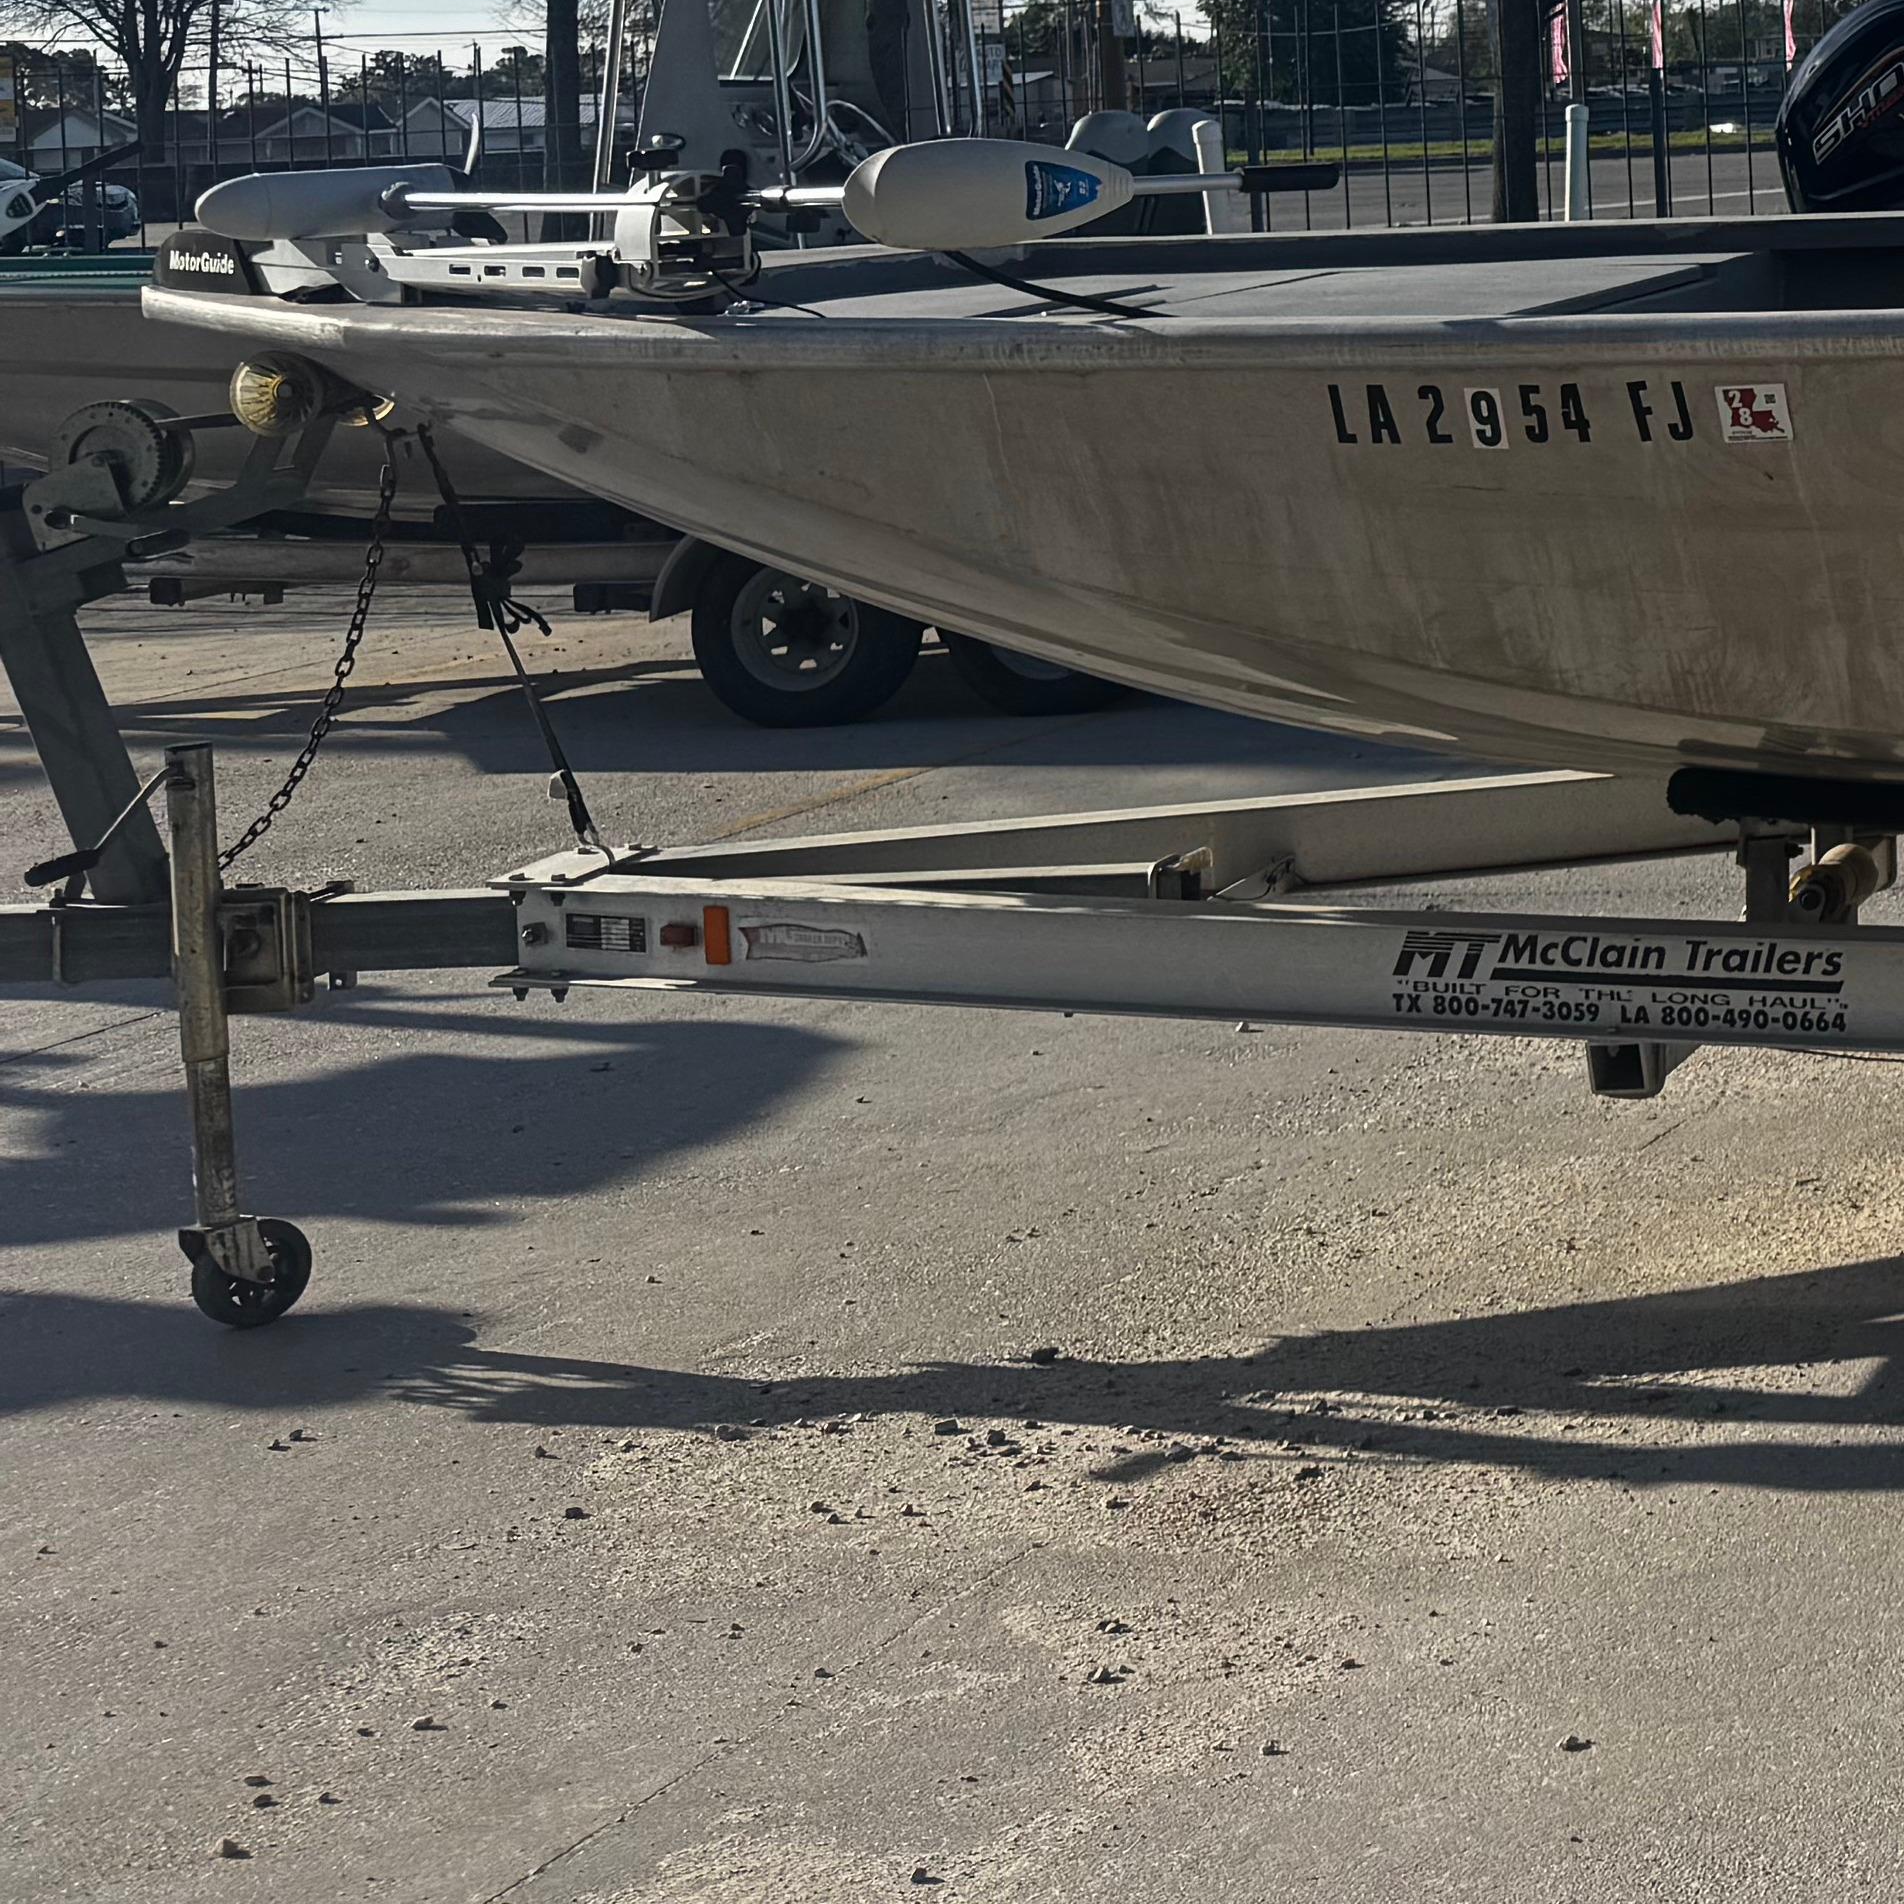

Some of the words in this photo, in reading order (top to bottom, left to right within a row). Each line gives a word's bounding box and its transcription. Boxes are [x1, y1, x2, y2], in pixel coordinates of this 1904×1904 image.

[168, 249, 235, 275] MotorGuide
[1498, 933, 1667, 970] McClain
[1685, 940, 1844, 976] Trailers
[1504, 985, 1561, 999] FOR
[1651, 992, 1731, 1007] LONG
[1392, 993, 1423, 1014] TX
[1432, 996, 1600, 1023] 800-747-3059
[1620, 1005, 1650, 1025] LA
[1660, 1006, 1847, 1033] 800-490-0664
